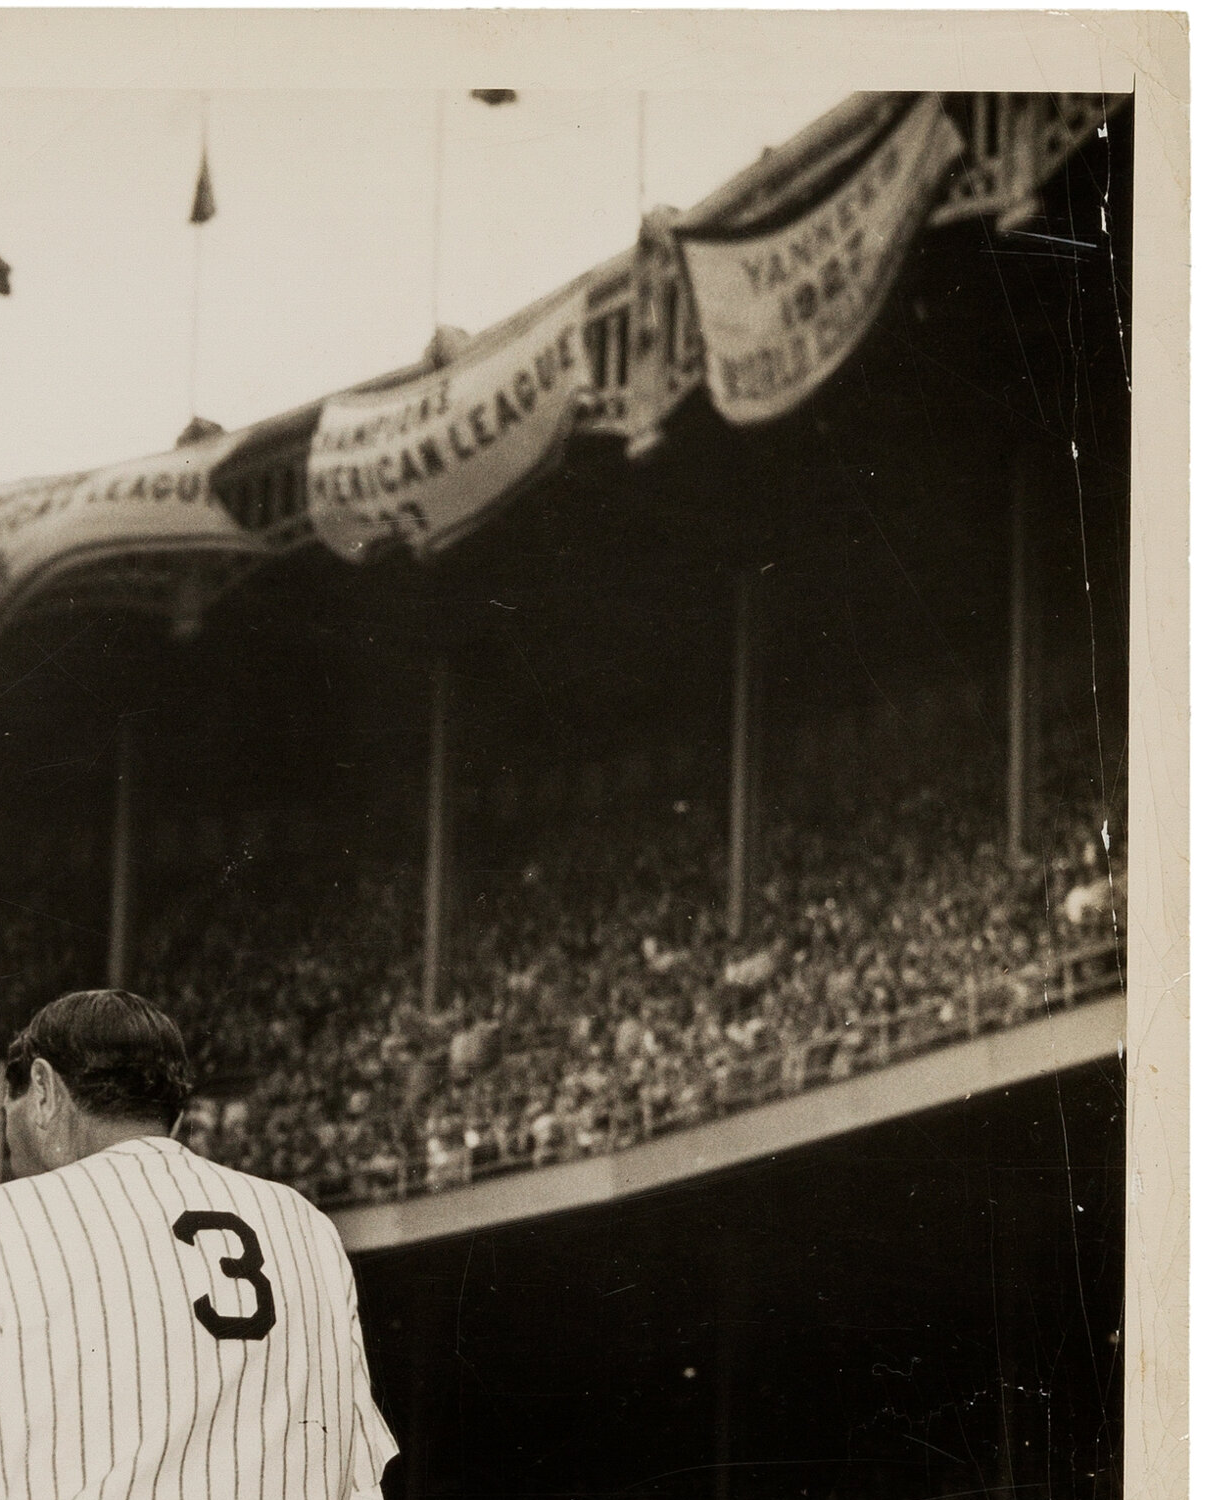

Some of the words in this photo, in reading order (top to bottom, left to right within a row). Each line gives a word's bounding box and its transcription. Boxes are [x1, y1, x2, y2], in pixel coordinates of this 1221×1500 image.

[447, 323, 577, 461] LEAGUE
[85, 469, 219, 512] LEAGU
[172, 1210, 276, 1340] 3
